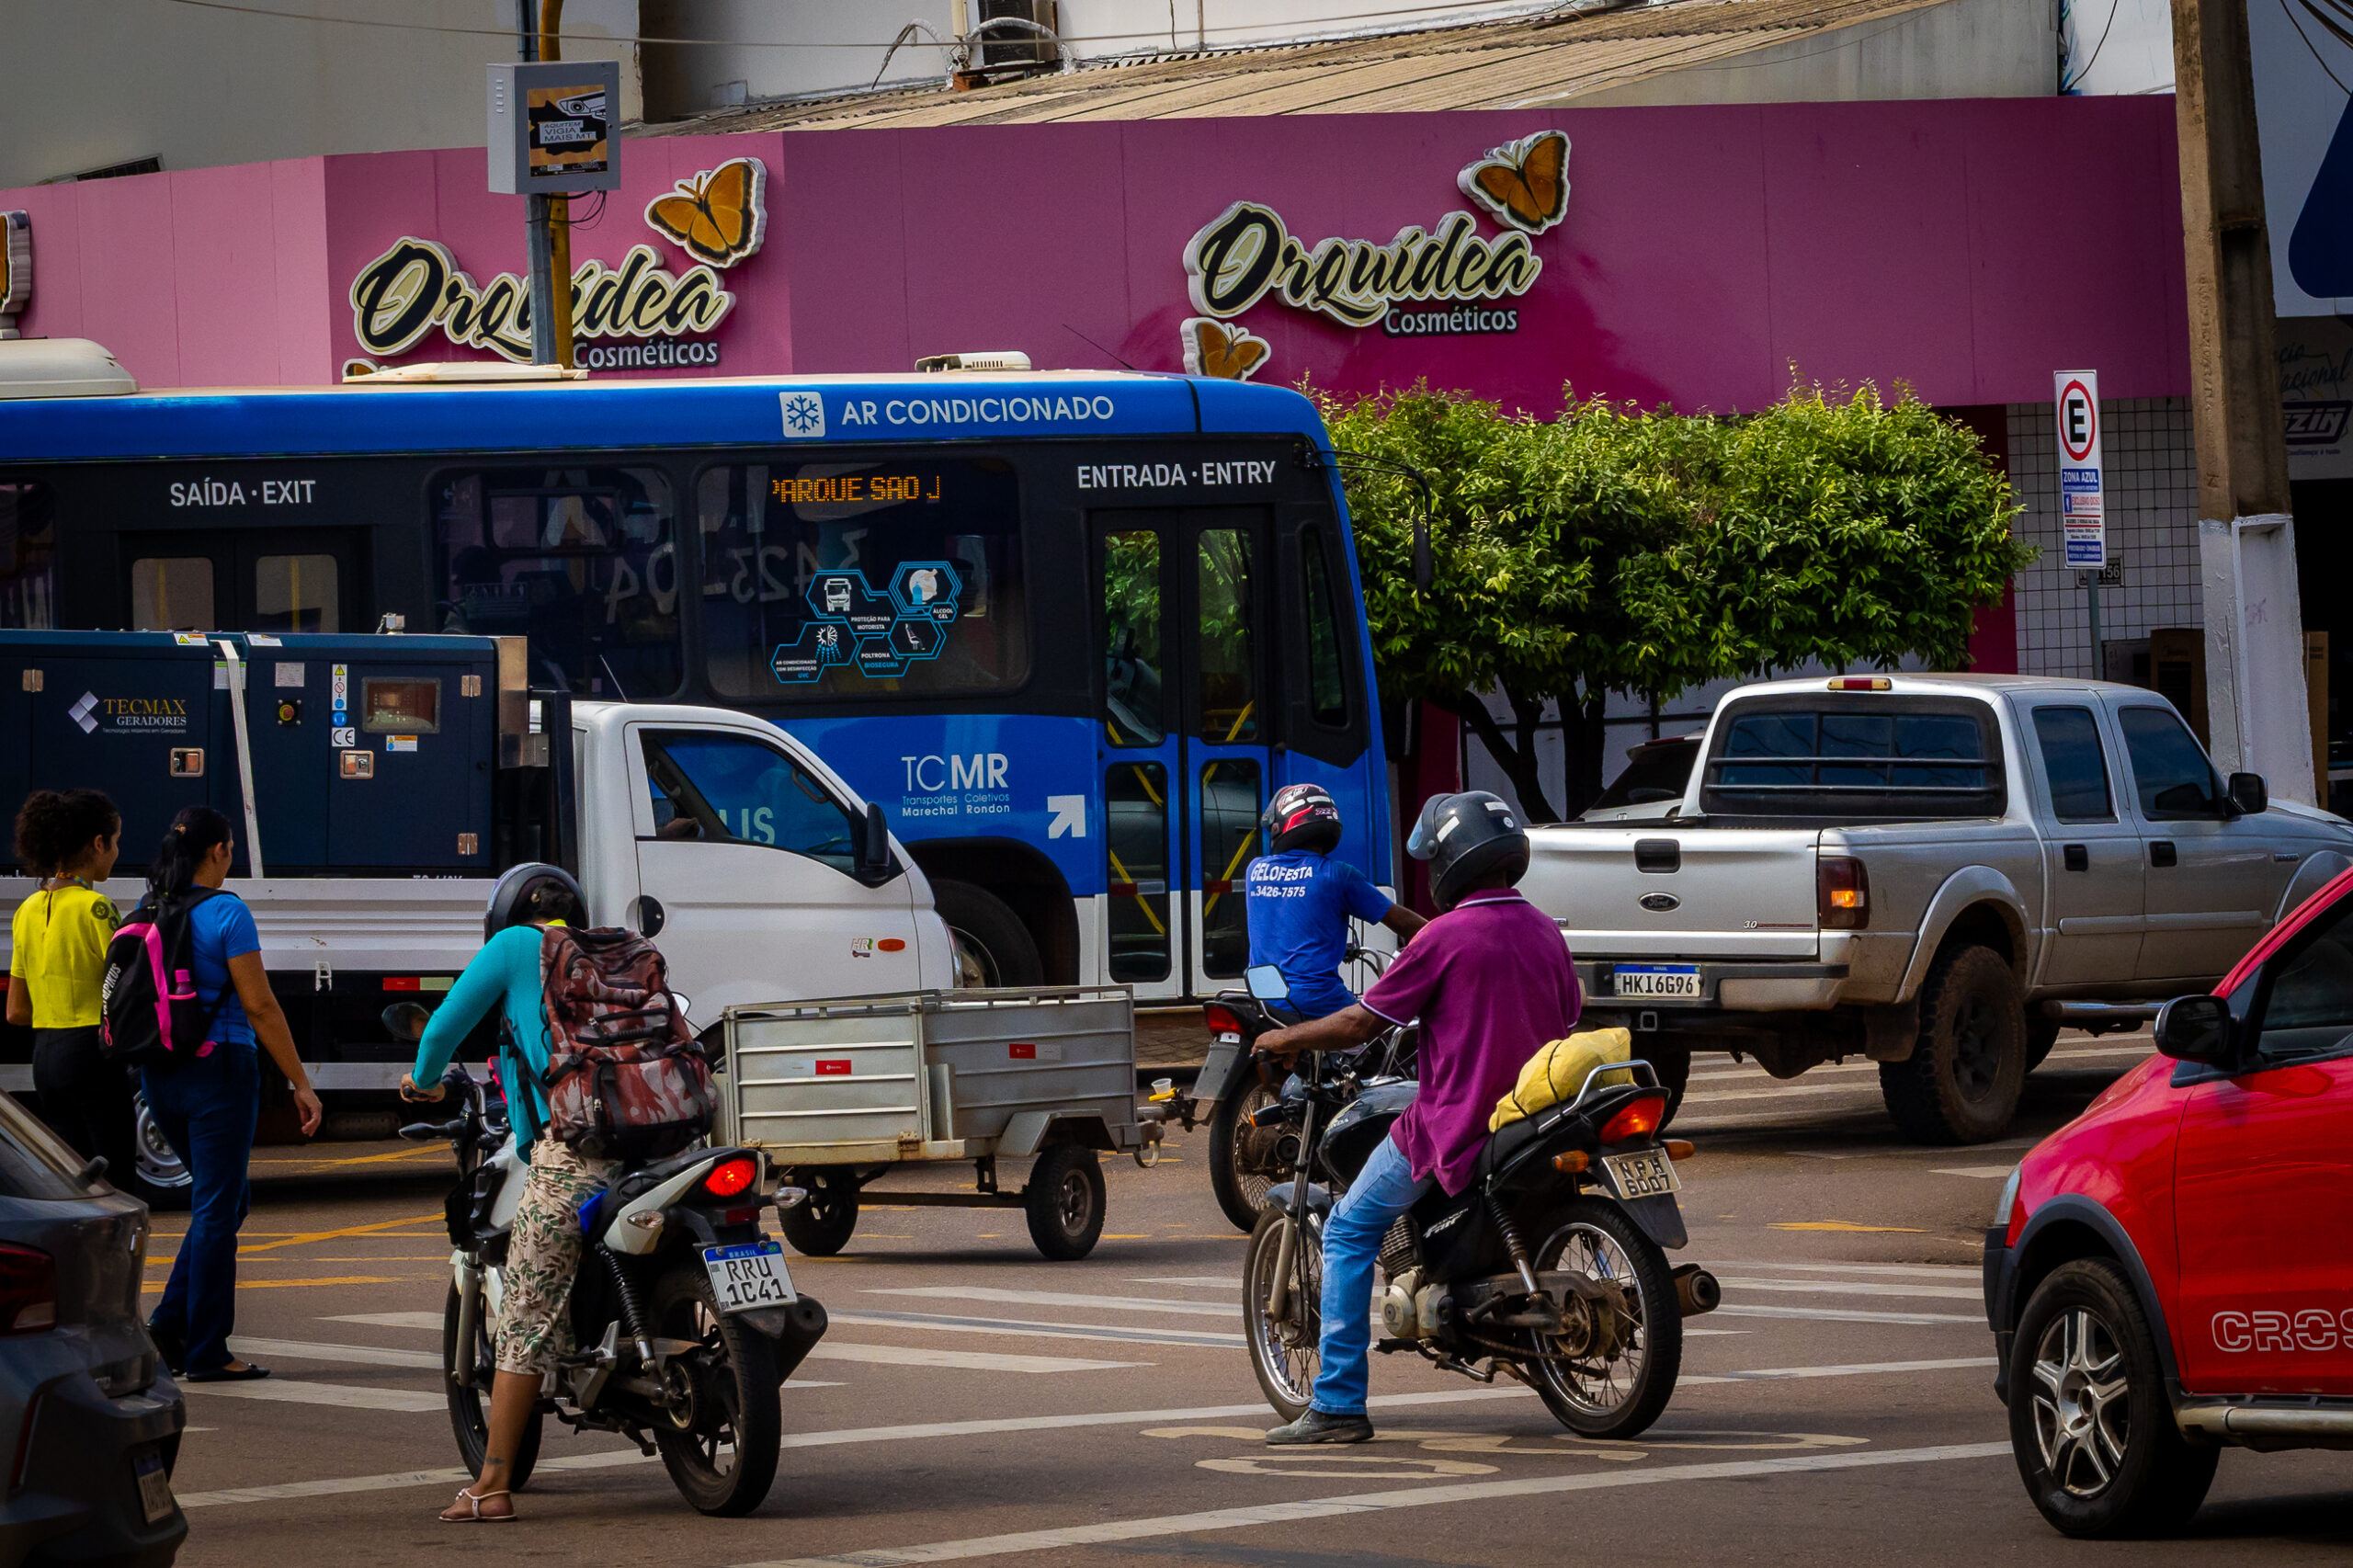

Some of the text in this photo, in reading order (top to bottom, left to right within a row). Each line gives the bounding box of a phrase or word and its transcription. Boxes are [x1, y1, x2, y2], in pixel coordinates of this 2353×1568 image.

[1197, 206, 1540, 322] Orquídea
[1385, 306, 1518, 334] Cosméticos
[574, 340, 718, 369] Cosméticos
[842, 395, 1115, 425] AR CONDICIONADO
[2068, 399, 2086, 443] E
[1077, 460, 1277, 489] ENTRADA ENTRY
[2063, 471, 2098, 483] ZONA AZUL
[170, 477, 316, 506] SAÍDA EXIT
[771, 477, 864, 503] ARQUE
[870, 476, 919, 499] SAO
[851, 615, 875, 624] PROTEÇÃO
[103, 699, 187, 715] TECMAX
[117, 716, 187, 726] GERADORES
[902, 753, 1009, 791] TCMR
[902, 803, 1010, 816] Marechal Rondon
[903, 792, 1010, 807] Transportes Coletivos
[1251, 863, 1313, 882] GELOFESTA
[1256, 886, 1306, 898] 3426-7575
[1619, 1157, 1665, 1179] NPH
[729, 1250, 757, 1258] BRASIL
[725, 1256, 772, 1282] RRU
[727, 1278, 788, 1306] 1C41
